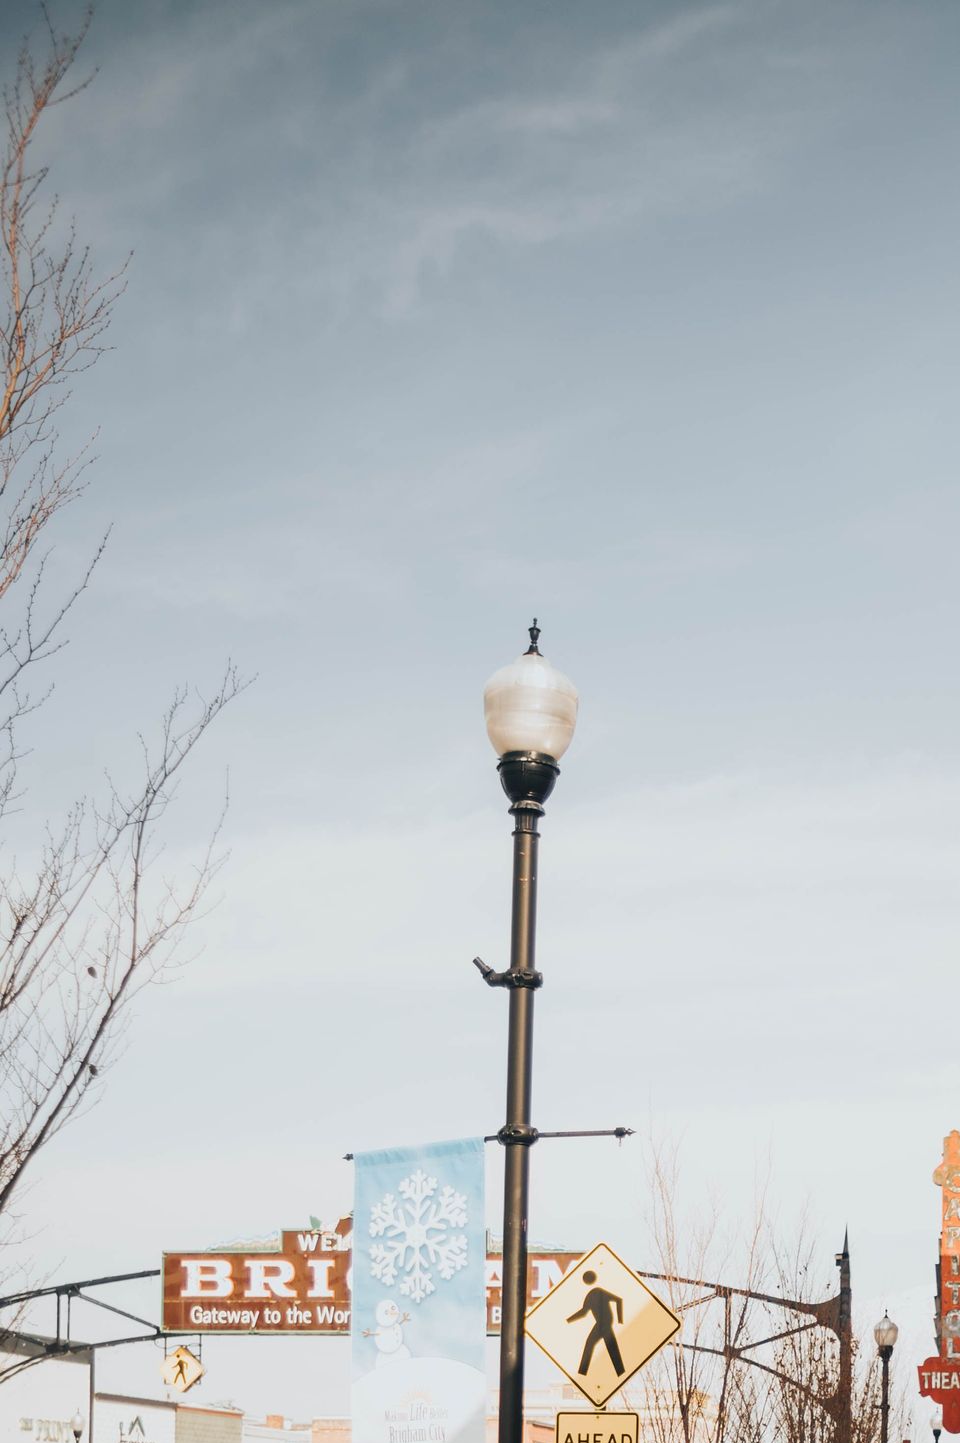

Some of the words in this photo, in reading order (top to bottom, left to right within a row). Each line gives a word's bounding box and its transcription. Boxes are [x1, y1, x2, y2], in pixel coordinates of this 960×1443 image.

[190, 1305, 259, 1327] Gateway
[264, 1307, 281, 1324] to
[286, 1305, 312, 1324] the
